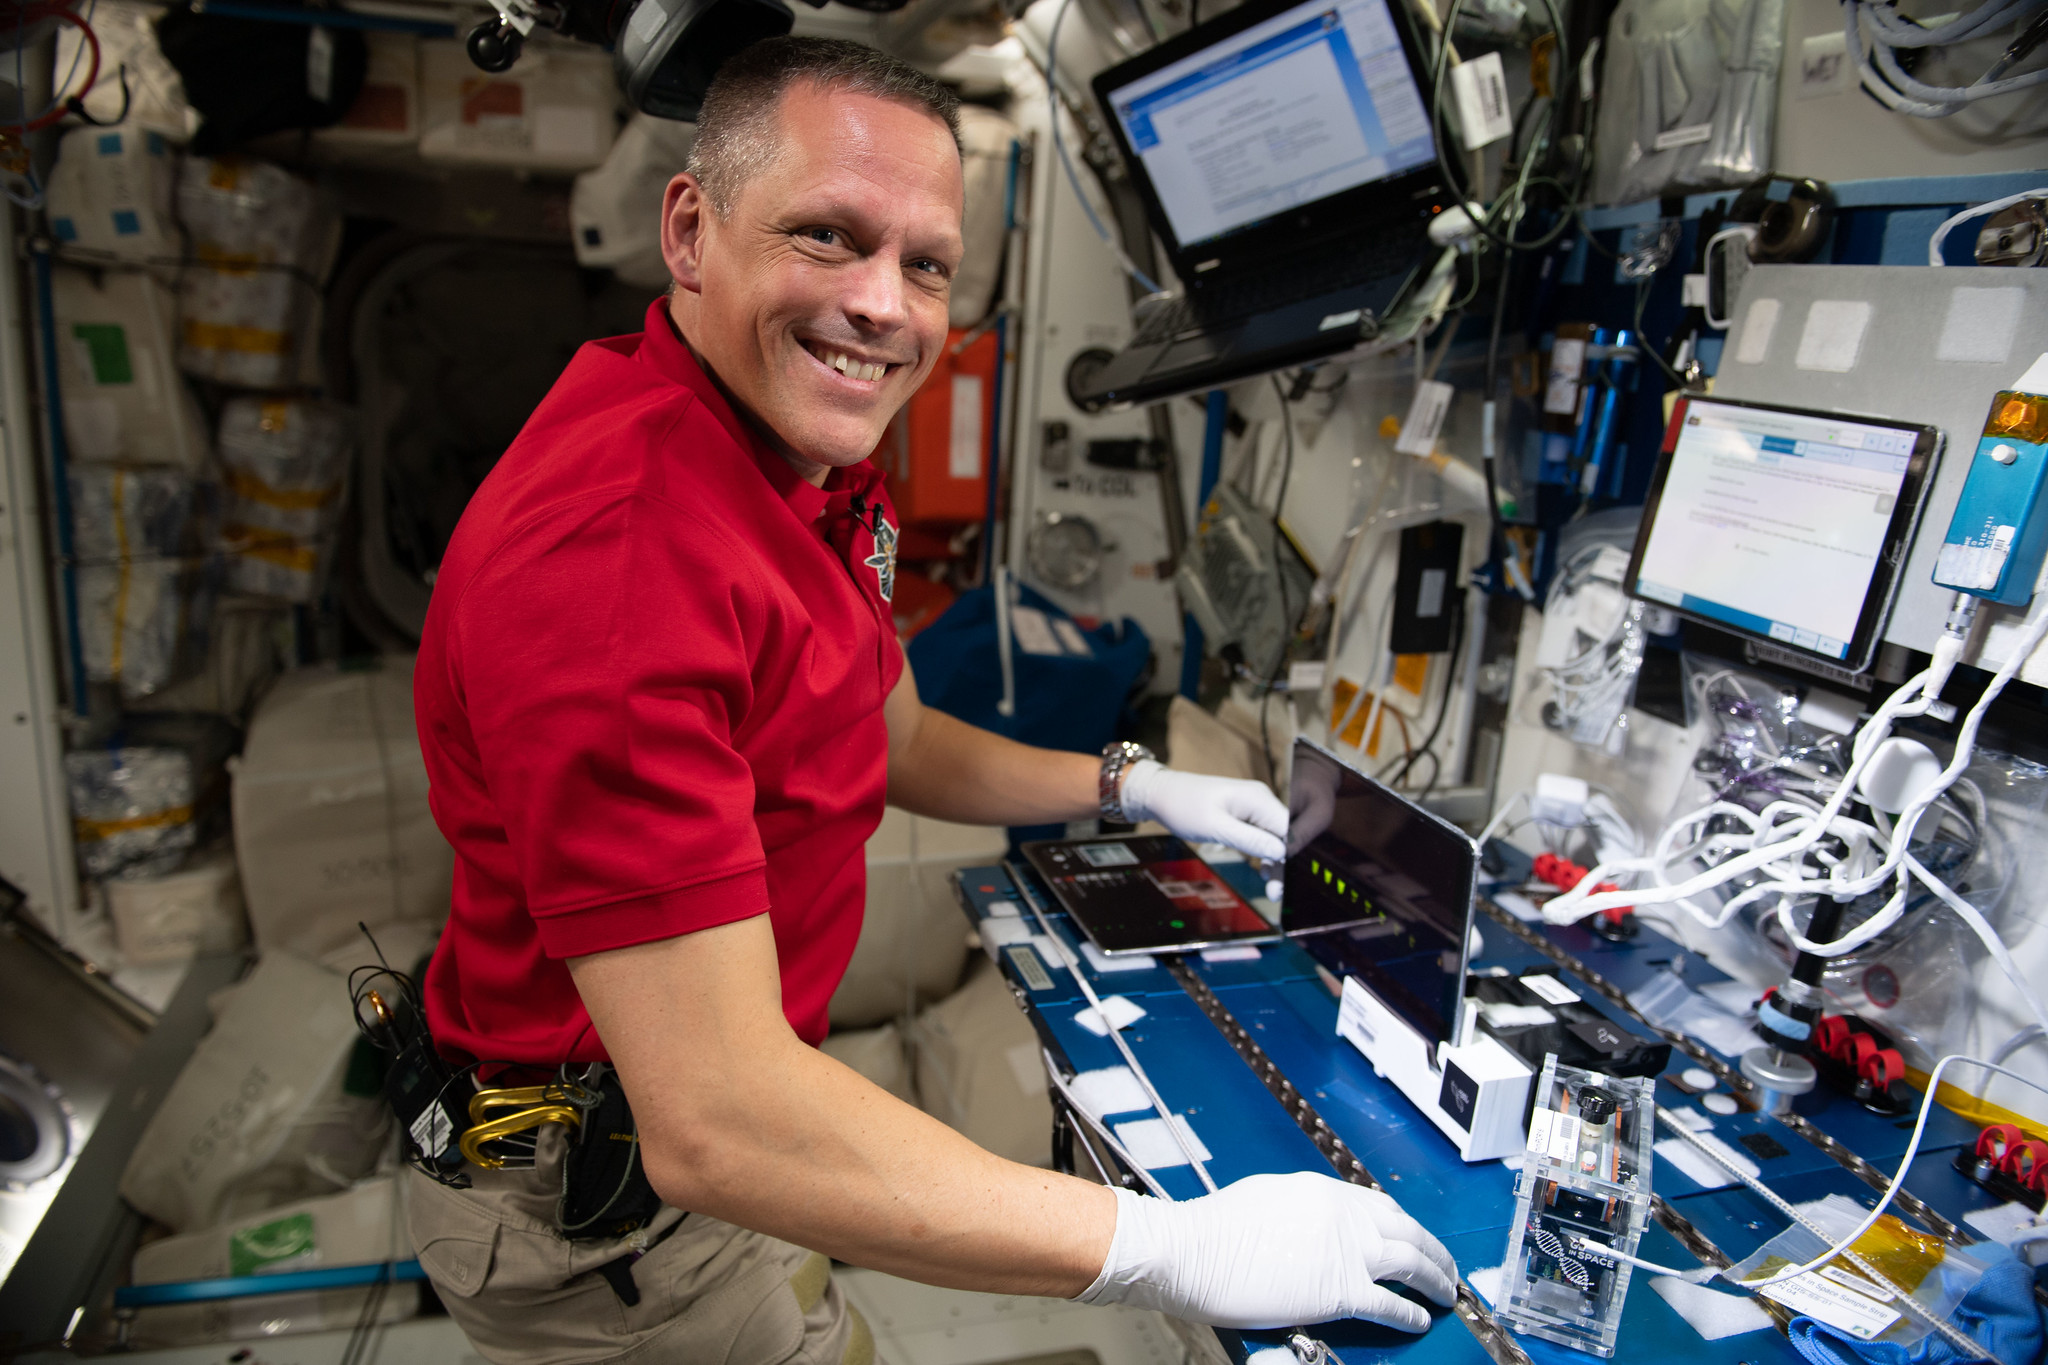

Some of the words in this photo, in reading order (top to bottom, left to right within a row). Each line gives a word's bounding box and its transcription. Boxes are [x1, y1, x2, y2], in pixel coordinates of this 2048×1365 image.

[1568, 1249, 1577, 1257] IN
[1577, 1251, 1615, 1269] SPACE
[1761, 1289, 1795, 1307] Quantity
[1816, 1283, 1838, 1296] Space
[1840, 1294, 1868, 1310] Sample
[1869, 1307, 1888, 1318] Strip
